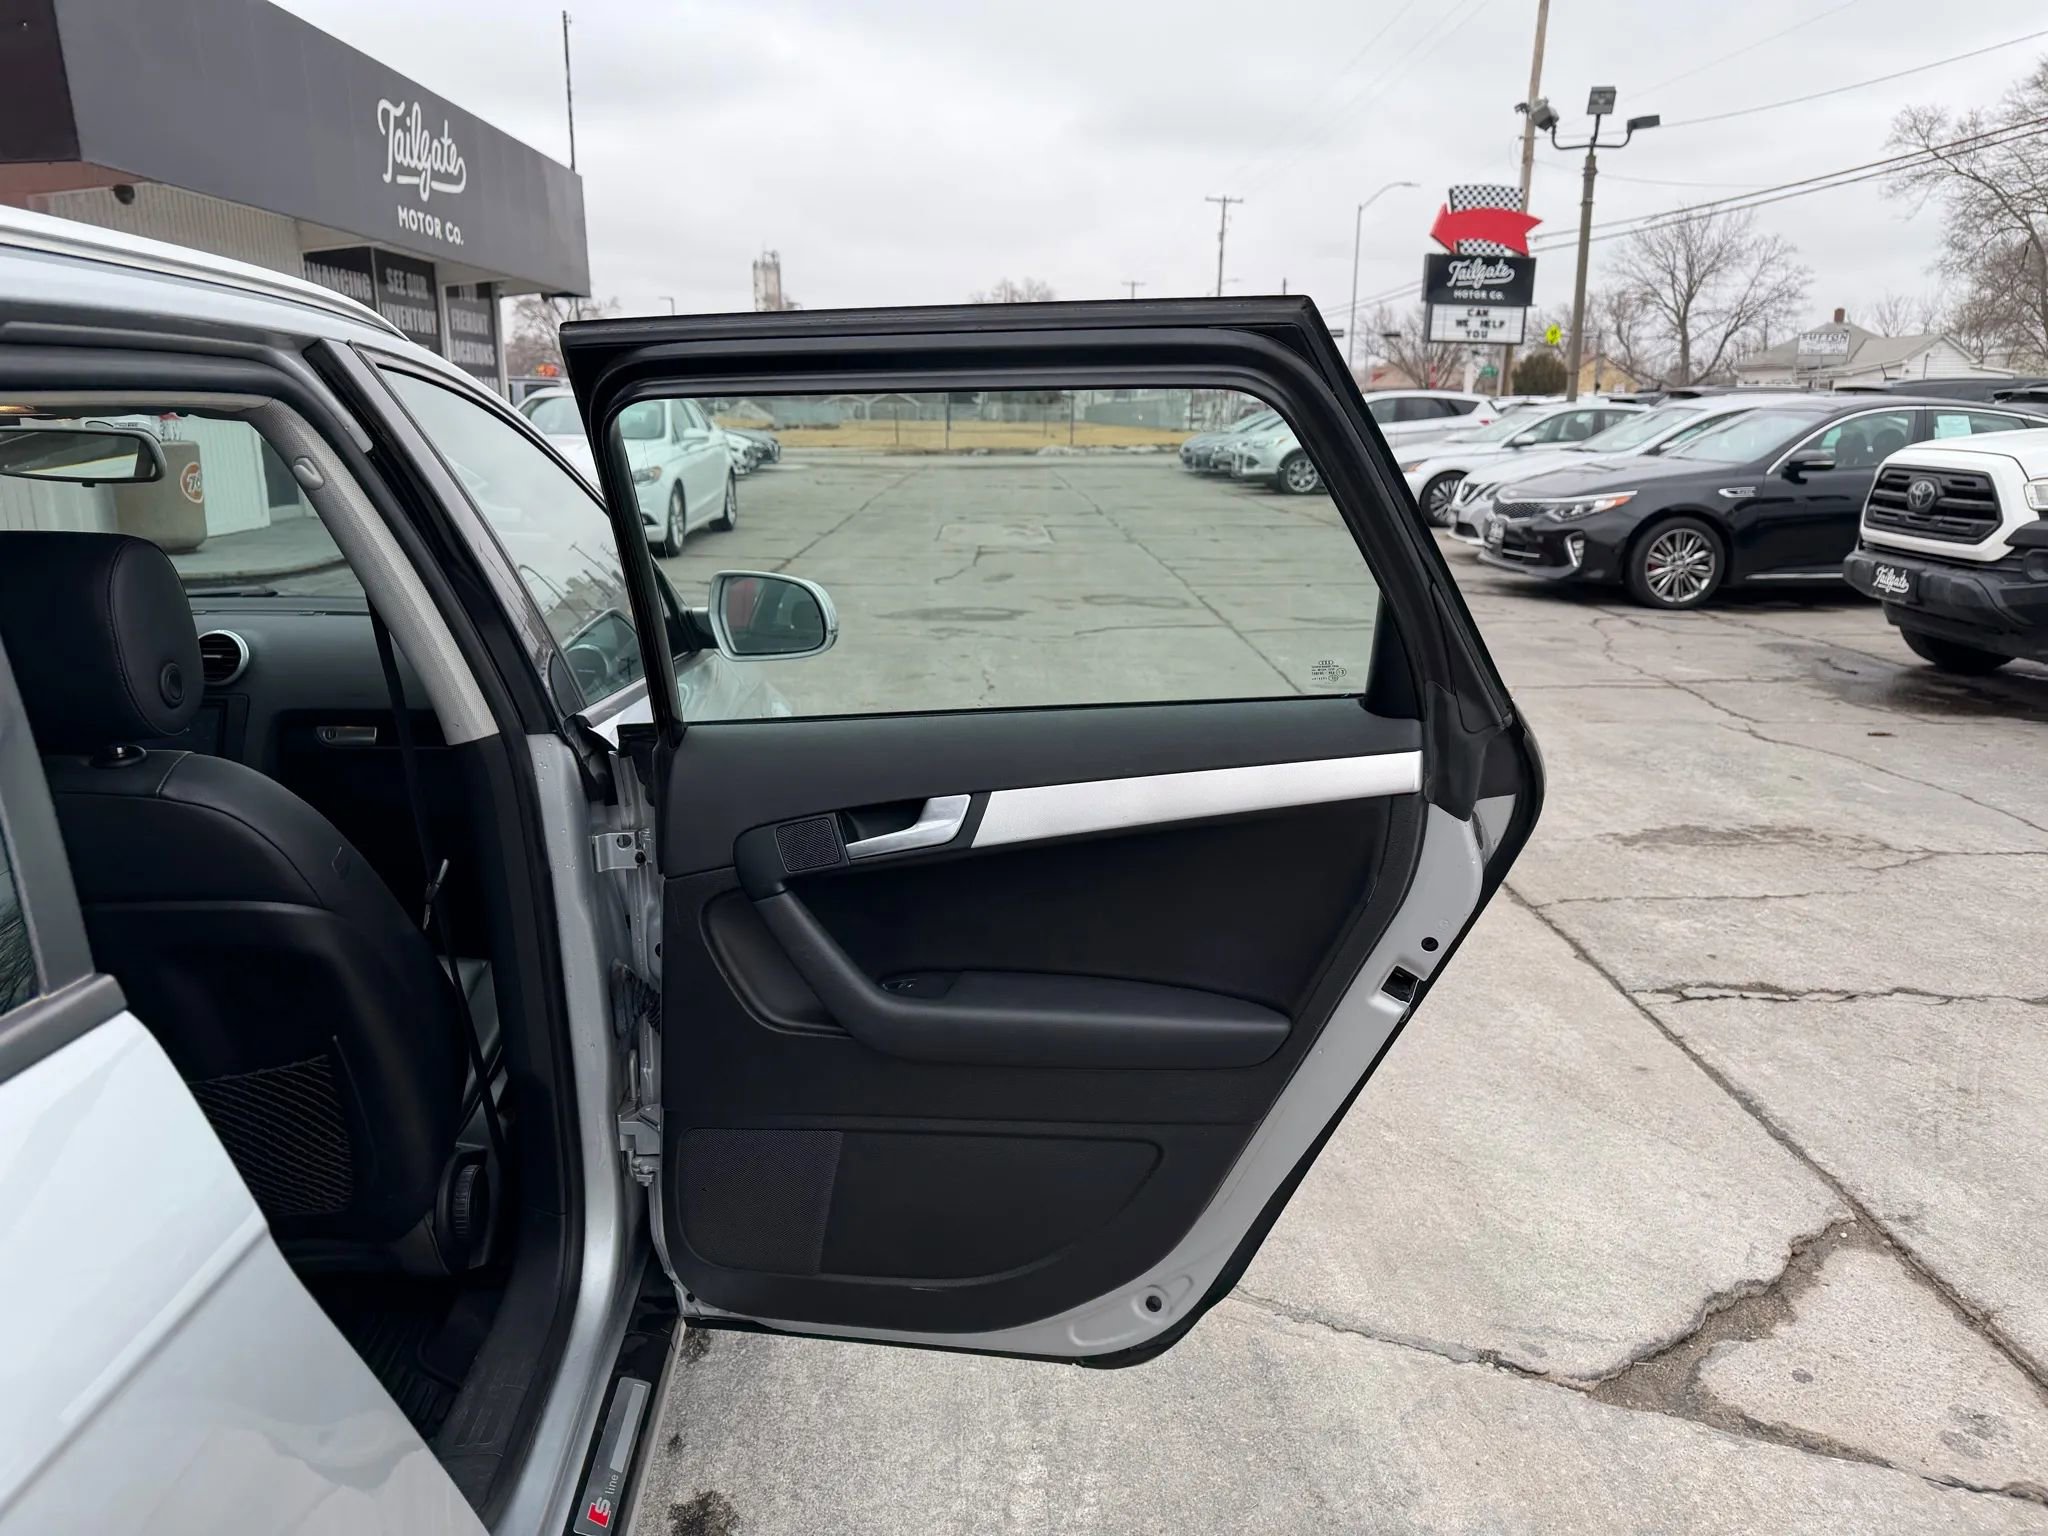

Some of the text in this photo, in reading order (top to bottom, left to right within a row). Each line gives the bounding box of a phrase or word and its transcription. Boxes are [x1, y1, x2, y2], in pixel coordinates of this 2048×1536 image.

[377, 98, 467, 202] Tailgate
[397, 205, 464, 246] MOTOR CO.
[303, 260, 373, 300] INANCING
[385, 266, 407, 296] SEE
[1446, 257, 1516, 289] Tailgate
[1453, 289, 1504, 301] MOTOR CO.
[1456, 319, 1505, 329] WE HELP
[1467, 308, 1489, 318] CAN
[1466, 330, 1489, 339] YOU
[1872, 564, 1910, 594] Tailgate
[604, 1474, 619, 1495] line
